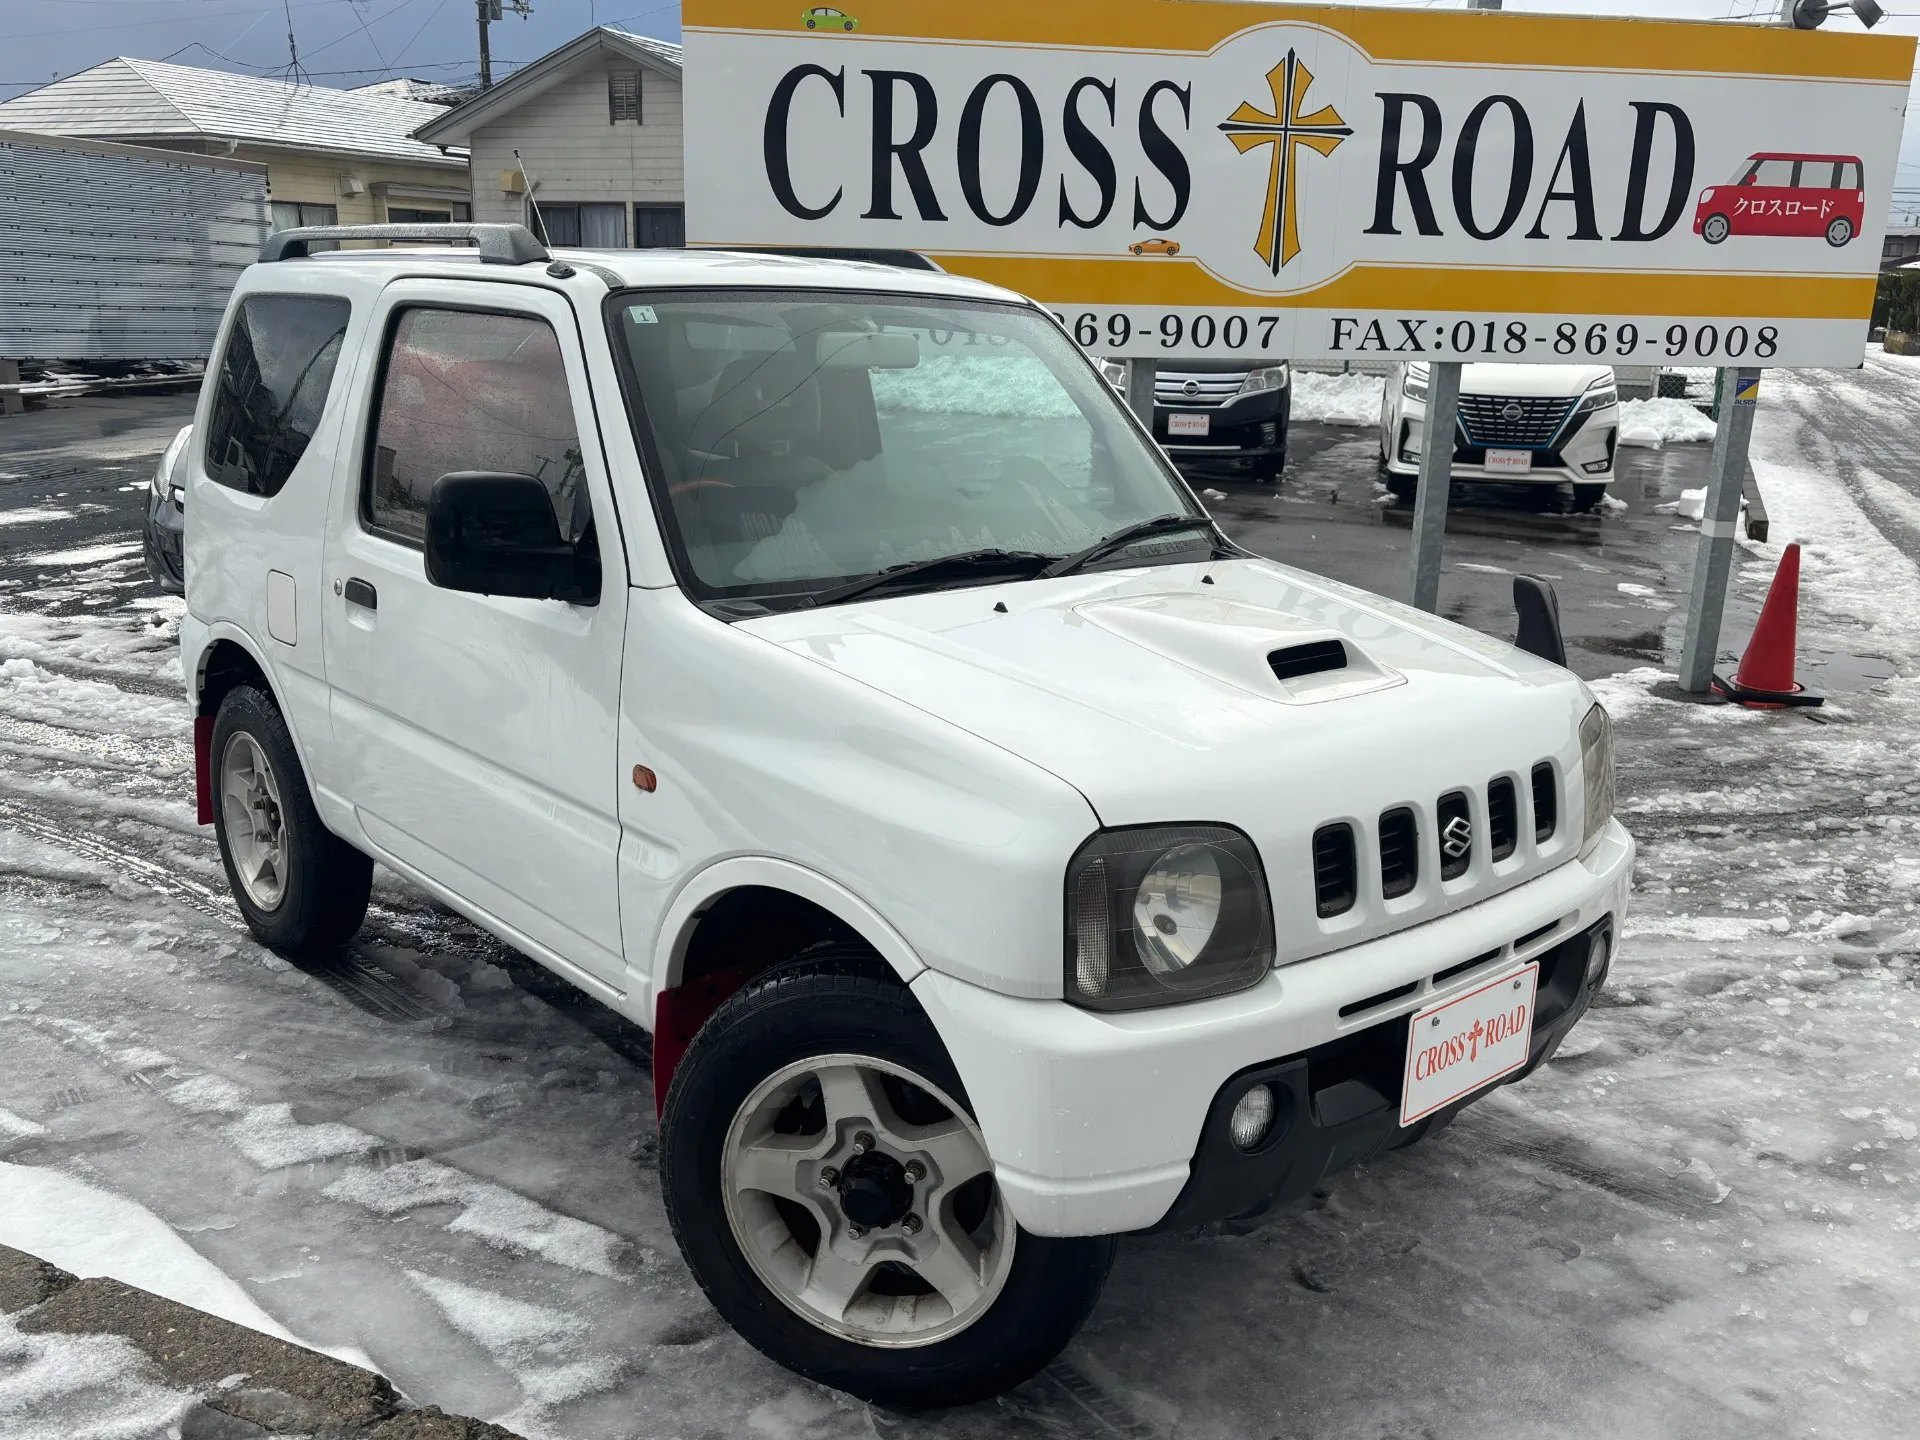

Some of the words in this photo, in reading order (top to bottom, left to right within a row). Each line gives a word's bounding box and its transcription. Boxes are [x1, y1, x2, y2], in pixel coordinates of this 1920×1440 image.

[763, 63, 1192, 231] CROSS
[1362, 92, 1696, 242] ROAD
[1732, 197, 1834, 219] クロスロード
[1415, 1032, 1466, 1081] CROSS
[1484, 1004, 1526, 1048] ROAD
